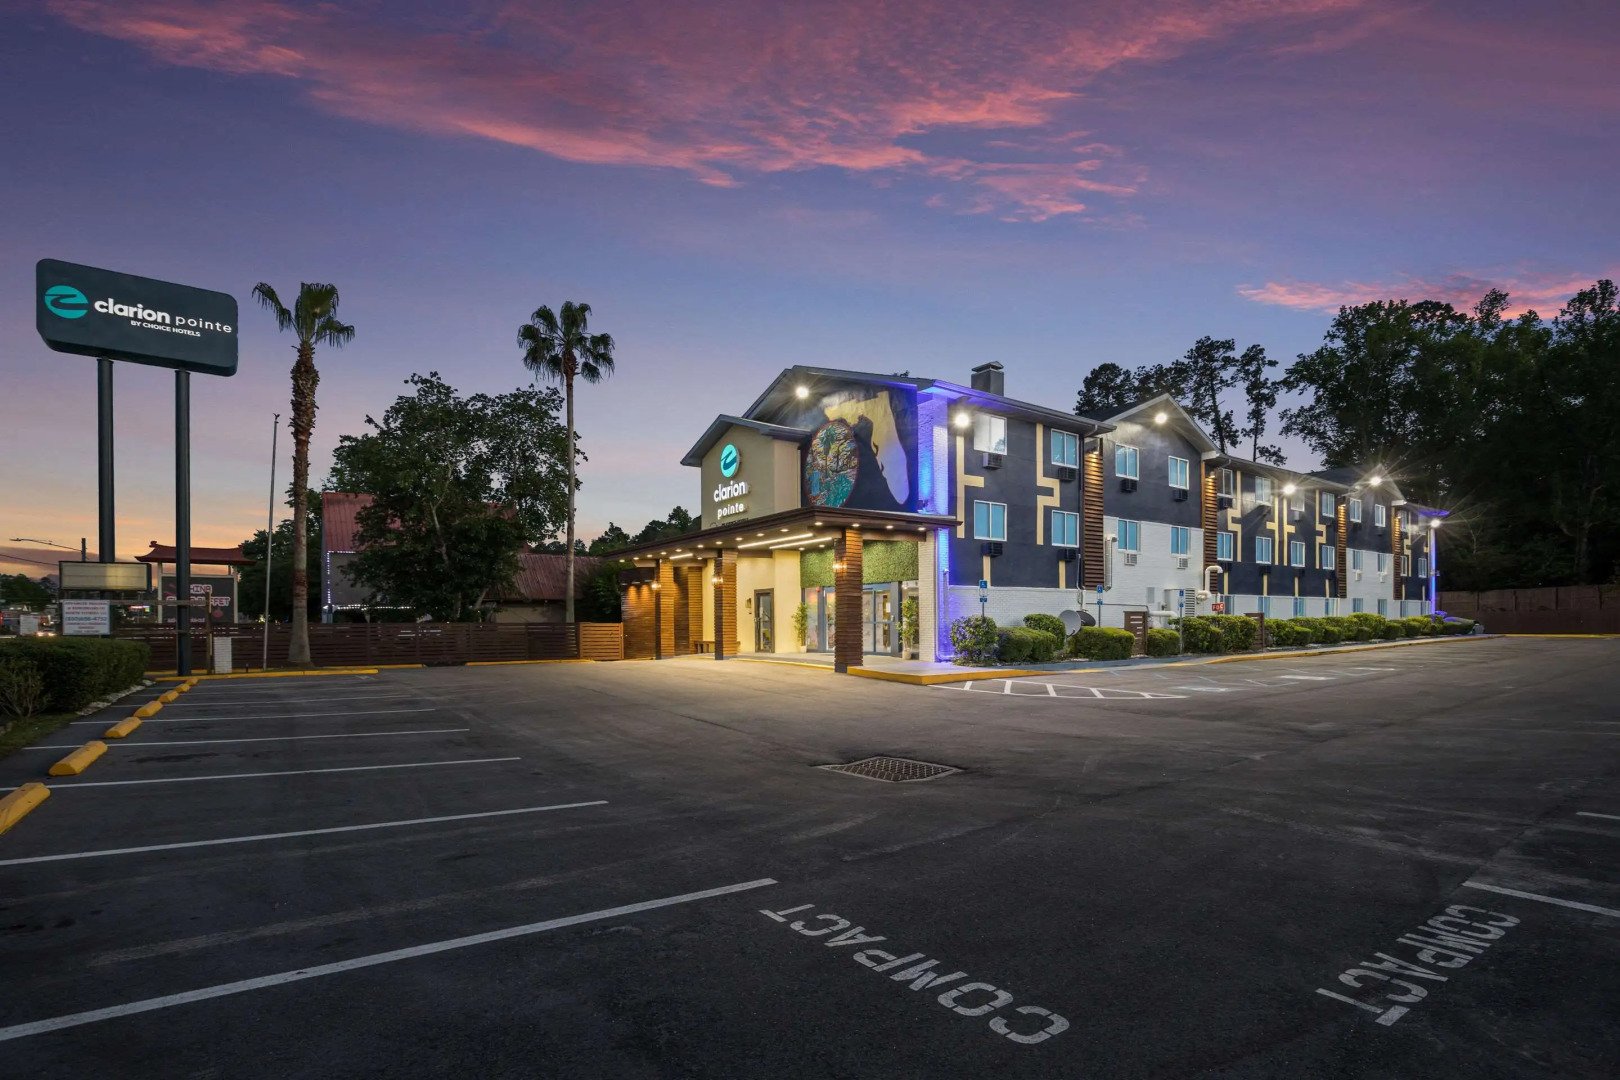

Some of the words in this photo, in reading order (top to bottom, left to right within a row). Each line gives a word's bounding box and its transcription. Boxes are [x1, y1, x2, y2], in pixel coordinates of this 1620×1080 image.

[94, 298, 170, 324] clarion
[175, 316, 232, 333] pointe
[142, 322, 171, 332] CHOICE
[172, 327, 201, 337] HOTELS
[713, 481, 747, 502] clarion
[717, 503, 744, 520] pointe
[190, 584, 213, 594] HINA
[759, 903, 1070, 1044] COMPACT
[1315, 904, 1520, 1026] COMPACT
